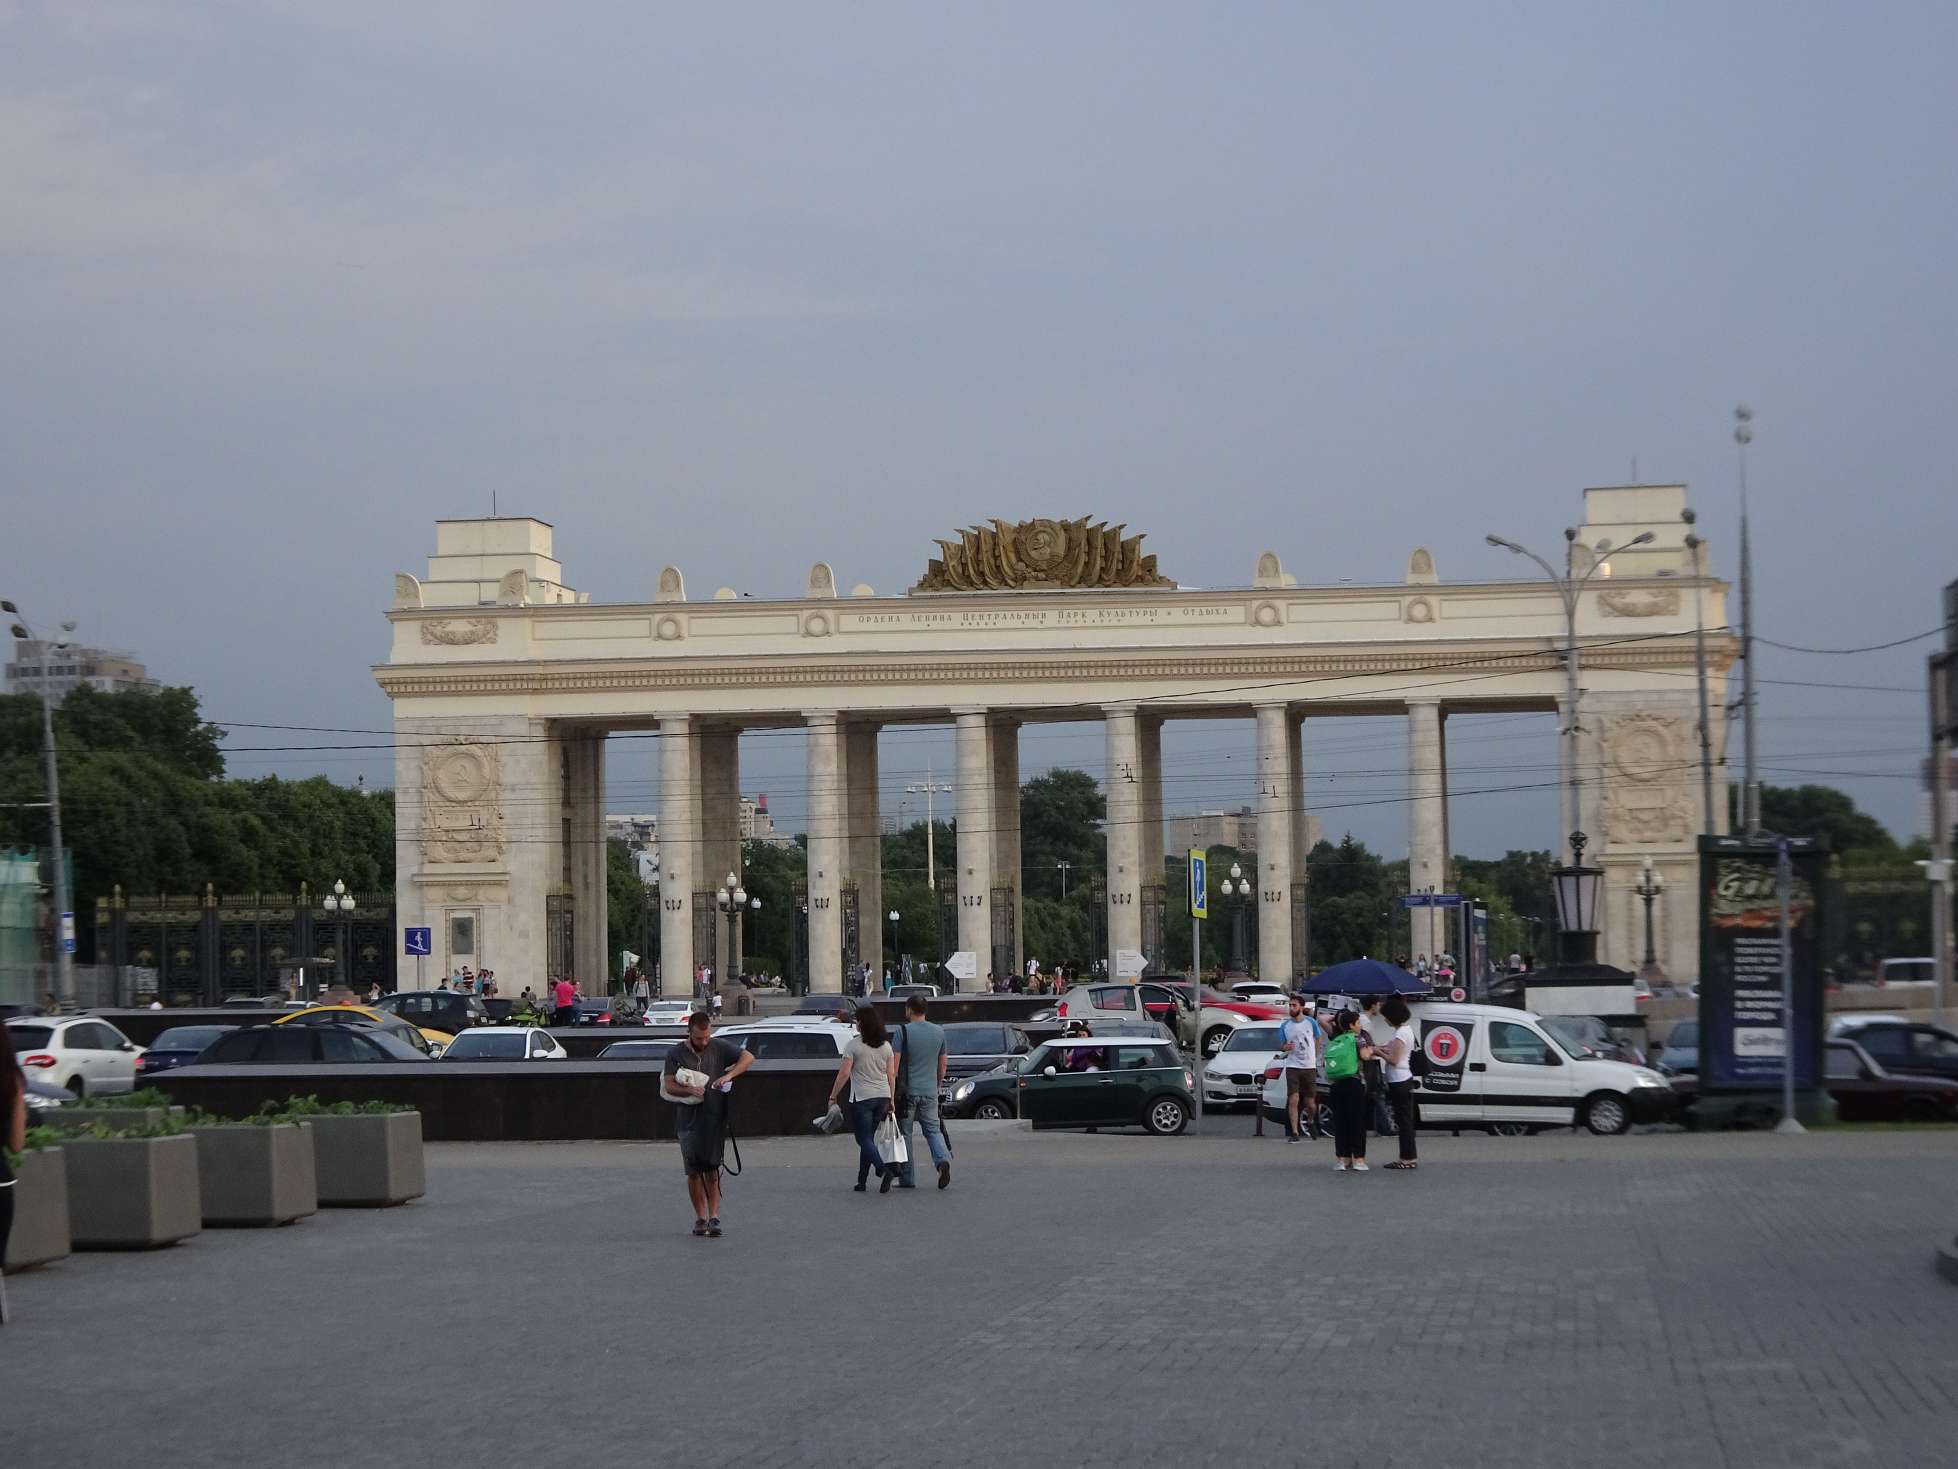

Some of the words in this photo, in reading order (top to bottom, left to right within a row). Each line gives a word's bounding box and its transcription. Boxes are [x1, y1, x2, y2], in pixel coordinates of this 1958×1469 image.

[858, 615, 901, 623] ОРДЕНА
[911, 614, 952, 622] ЛЕНИНА
[962, 612, 1047, 621] ЦЕНТРАЛЬНЫЙ
[1058, 610, 1087, 619] ПАРК
[1098, 609, 1158, 618] КУЛЬТУРЫ
[1183, 608, 1228, 616] ОТДЫХА
